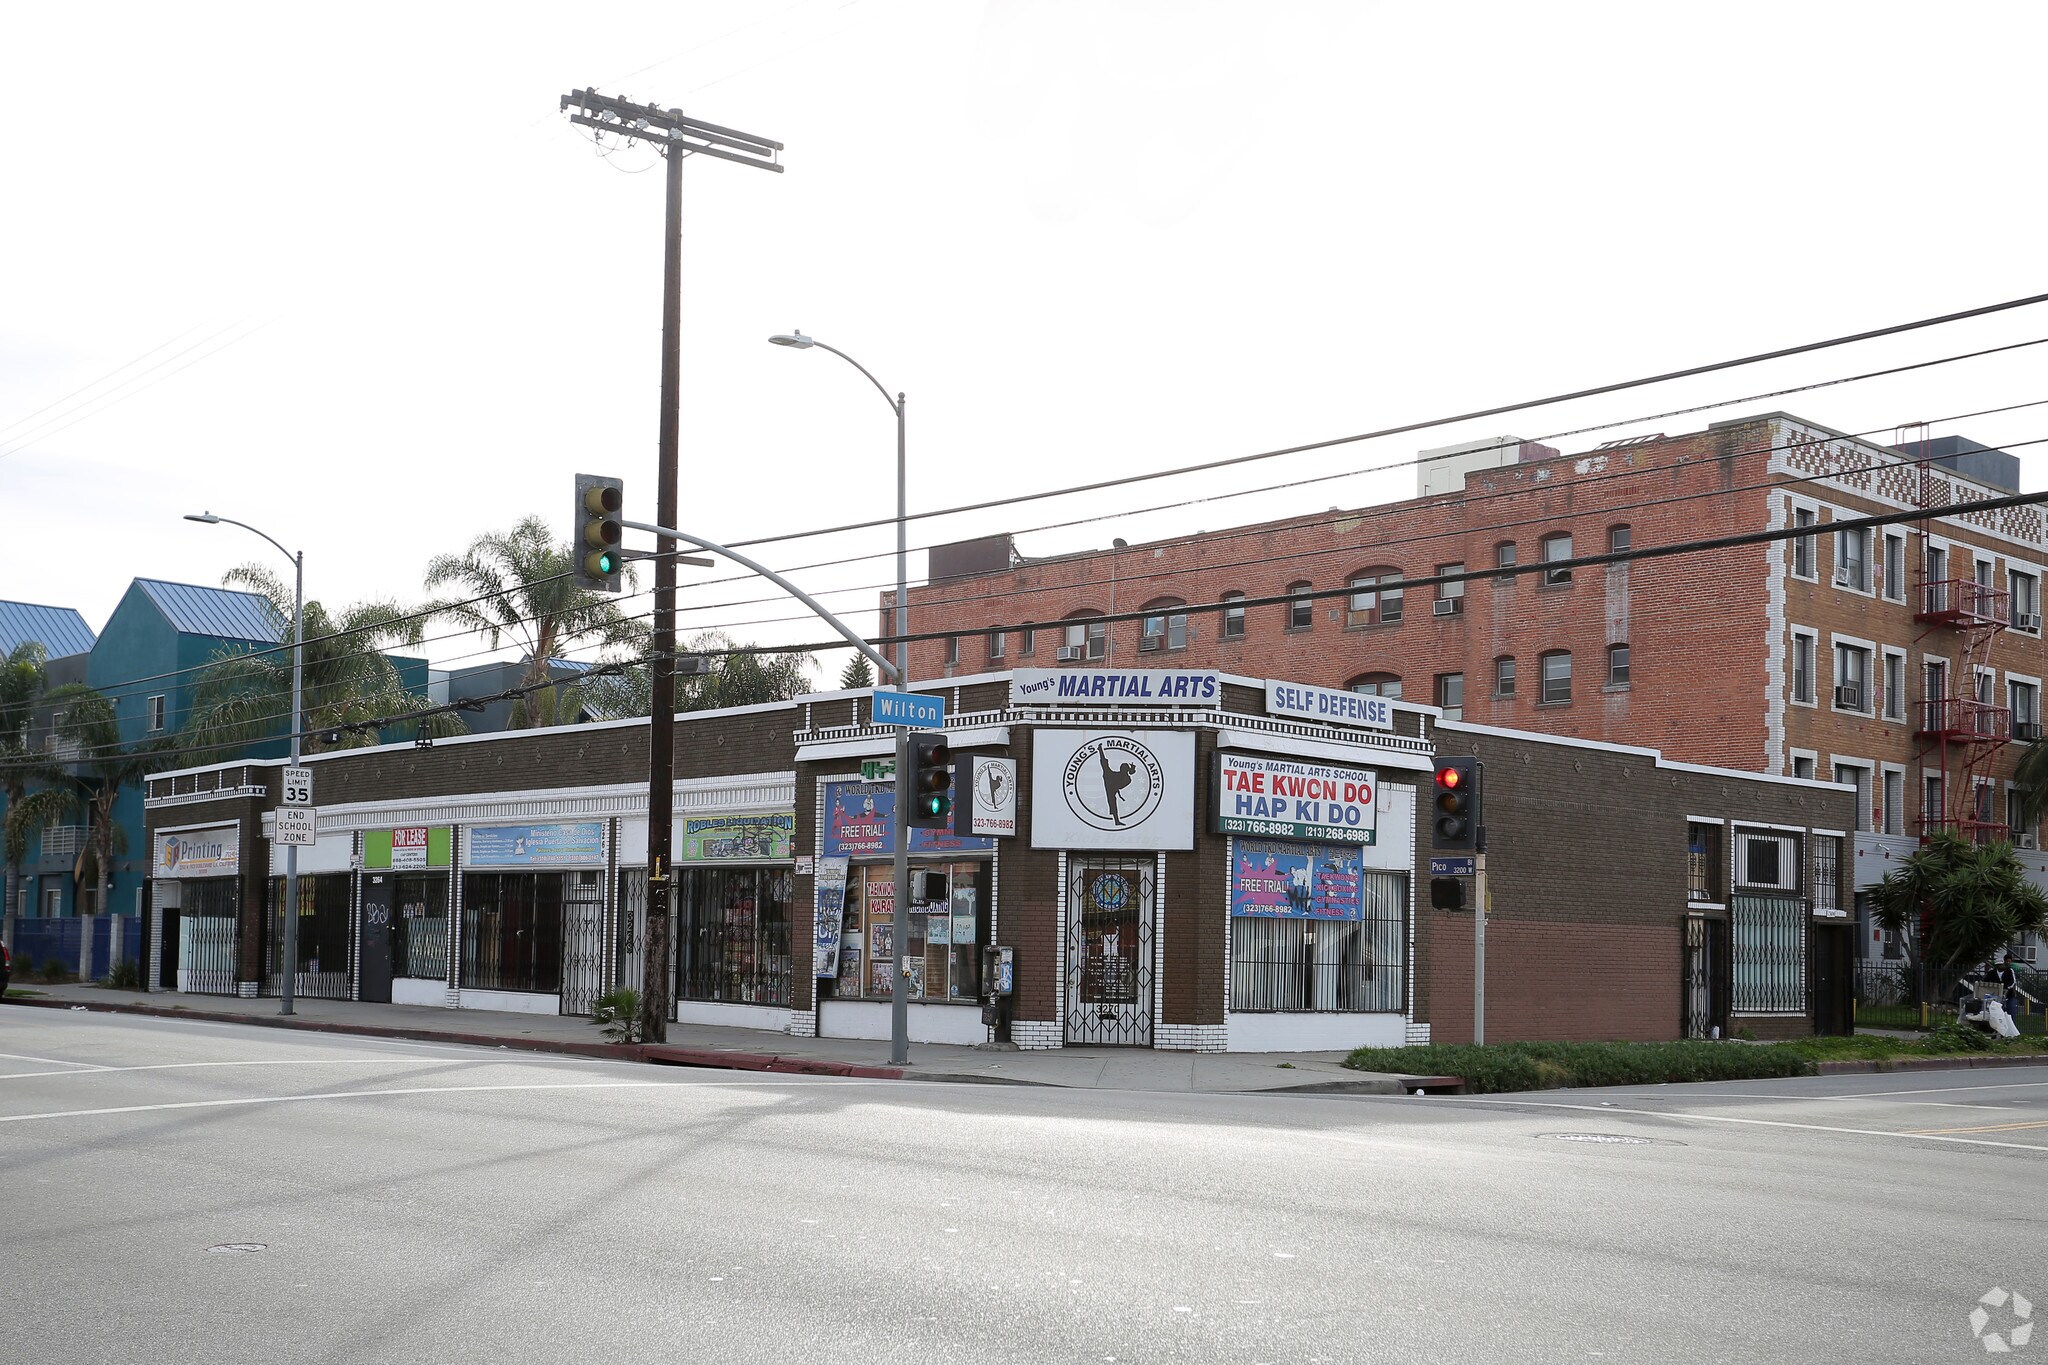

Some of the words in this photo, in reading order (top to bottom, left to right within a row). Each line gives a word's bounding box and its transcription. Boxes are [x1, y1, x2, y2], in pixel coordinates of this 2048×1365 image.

[1020, 676, 1055, 695] Young's
[1058, 676, 1152, 697] MARTIAL
[1158, 676, 1216, 698] ARTS
[881, 699, 936, 720] Wilton
[1276, 686, 1314, 711] SELF
[1319, 693, 1386, 723] DEFENSE
[1066, 745, 1096, 788] YOUNG'S
[1106, 740, 1149, 762] MARTIAL
[1148, 762, 1160, 789] ARTS
[1228, 757, 1262, 772] Young's
[1265, 762, 1305, 775] MARTIAL
[1308, 768, 1331, 778] ARTS
[1333, 772, 1368, 782] SCHOOL
[286, 770, 310, 778] SPEED
[845, 784, 870, 796] WORLD
[1224, 770, 1264, 794] TAE
[1344, 782, 1372, 804] DO
[286, 788, 308, 802] 35
[288, 812, 304, 820] END
[1236, 794, 1287, 818] HAP
[1296, 800, 1320, 822] KI
[1328, 804, 1360, 826] DO
[278, 822, 312, 831] SCHOOL
[687, 818, 725, 834] ROBLES
[726, 816, 793, 830] LIQUIDATION
[974, 818, 1013, 829] 323-766-8982
[1224, 819, 1246, 831] (323)
[1247, 820, 1294, 836] 766-8982
[1306, 826, 1325, 838] (213)
[1326, 828, 1370, 842] 268-6988
[284, 832, 306, 842] ZONE
[394, 830, 406, 846] FOR
[406, 828, 426, 845] LEASE
[840, 825, 860, 838] FREE
[861, 824, 885, 838] TRIAL!
[526, 838, 543, 847] Iglesia
[838, 842, 882, 852] (323)766-8982
[1240, 841, 1262, 854] WORLD
[1278, 844, 1304, 856] MARTIAL
[182, 841, 222, 860] Printing
[867, 882, 878, 896] TAE
[1240, 878, 1262, 892] FREE
[1243, 904, 1292, 914] (323)766-8982
[1316, 908, 1344, 916] FITNESS
